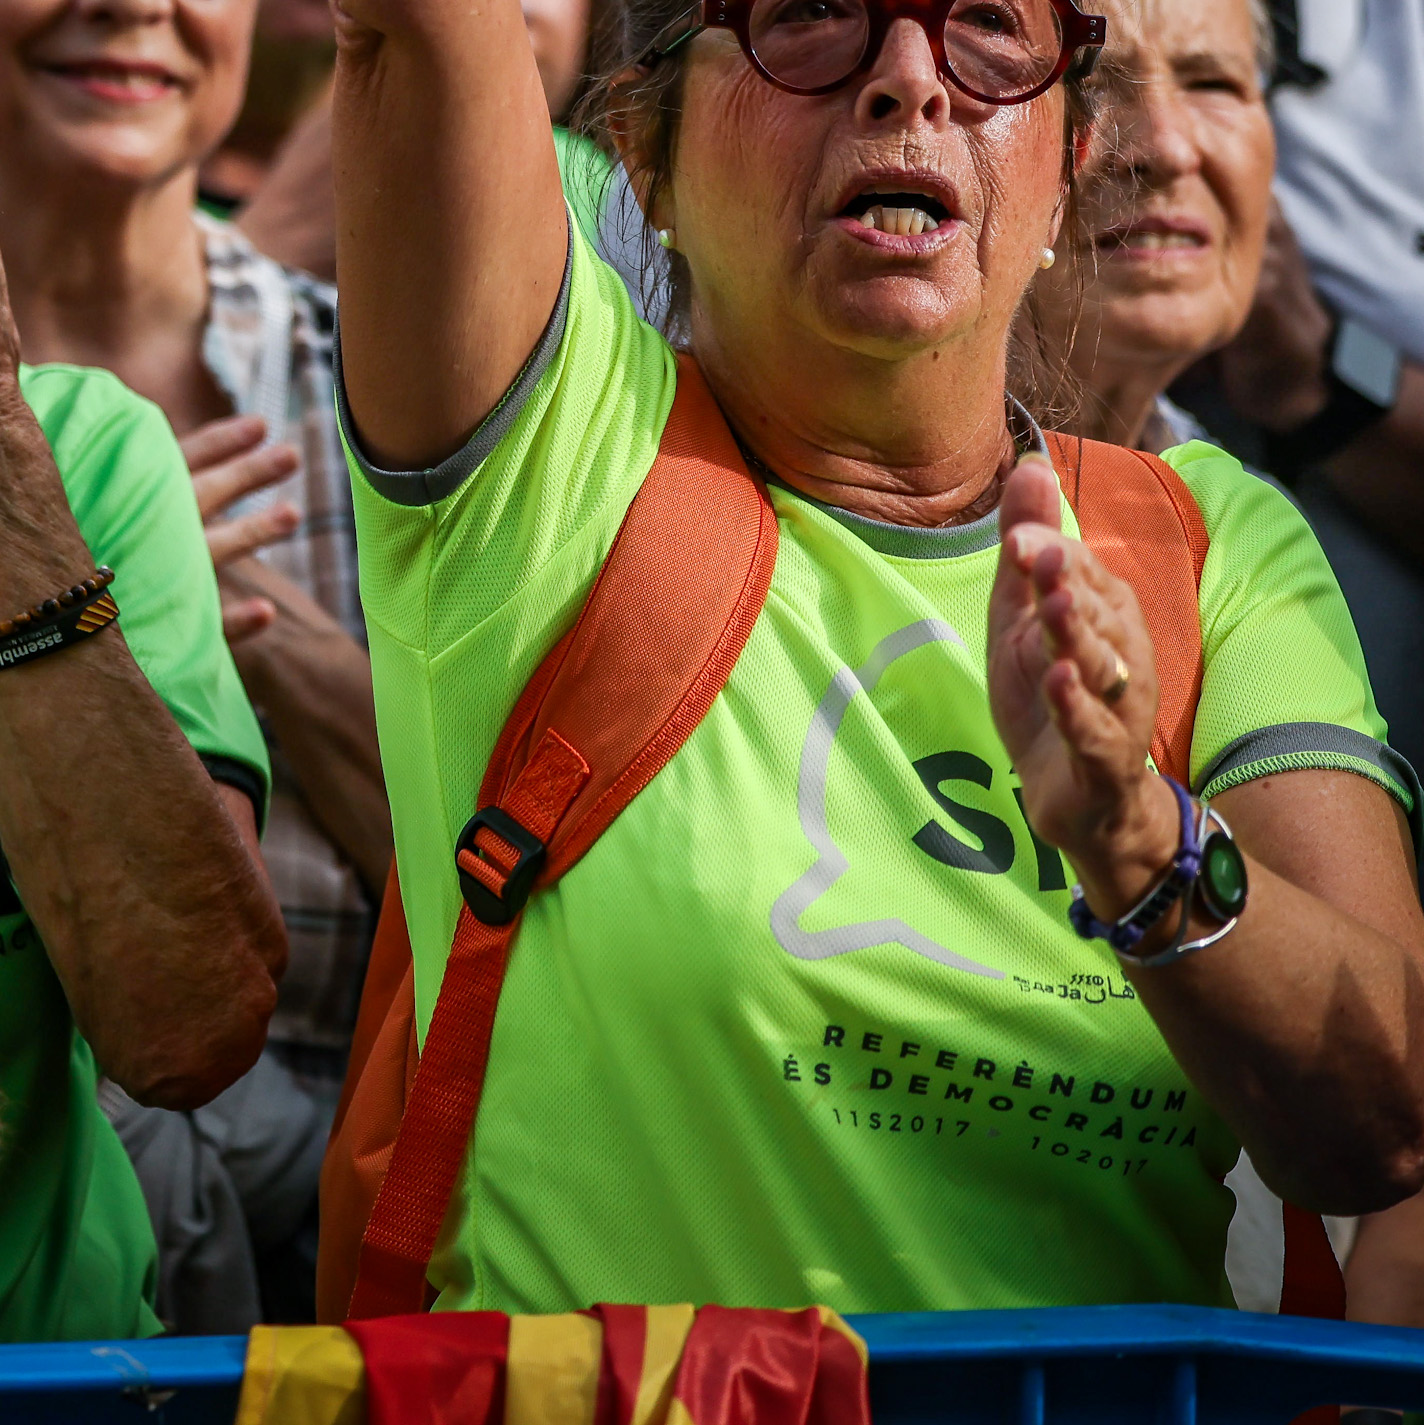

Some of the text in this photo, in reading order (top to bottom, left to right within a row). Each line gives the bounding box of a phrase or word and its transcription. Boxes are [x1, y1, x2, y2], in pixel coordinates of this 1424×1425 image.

[783, 1053, 1197, 1148] ÉS DEMOCRÀCIA
[823, 1025, 1187, 1112] REFERÈNDUM
[832, 1108, 972, 1137] 11S2017
